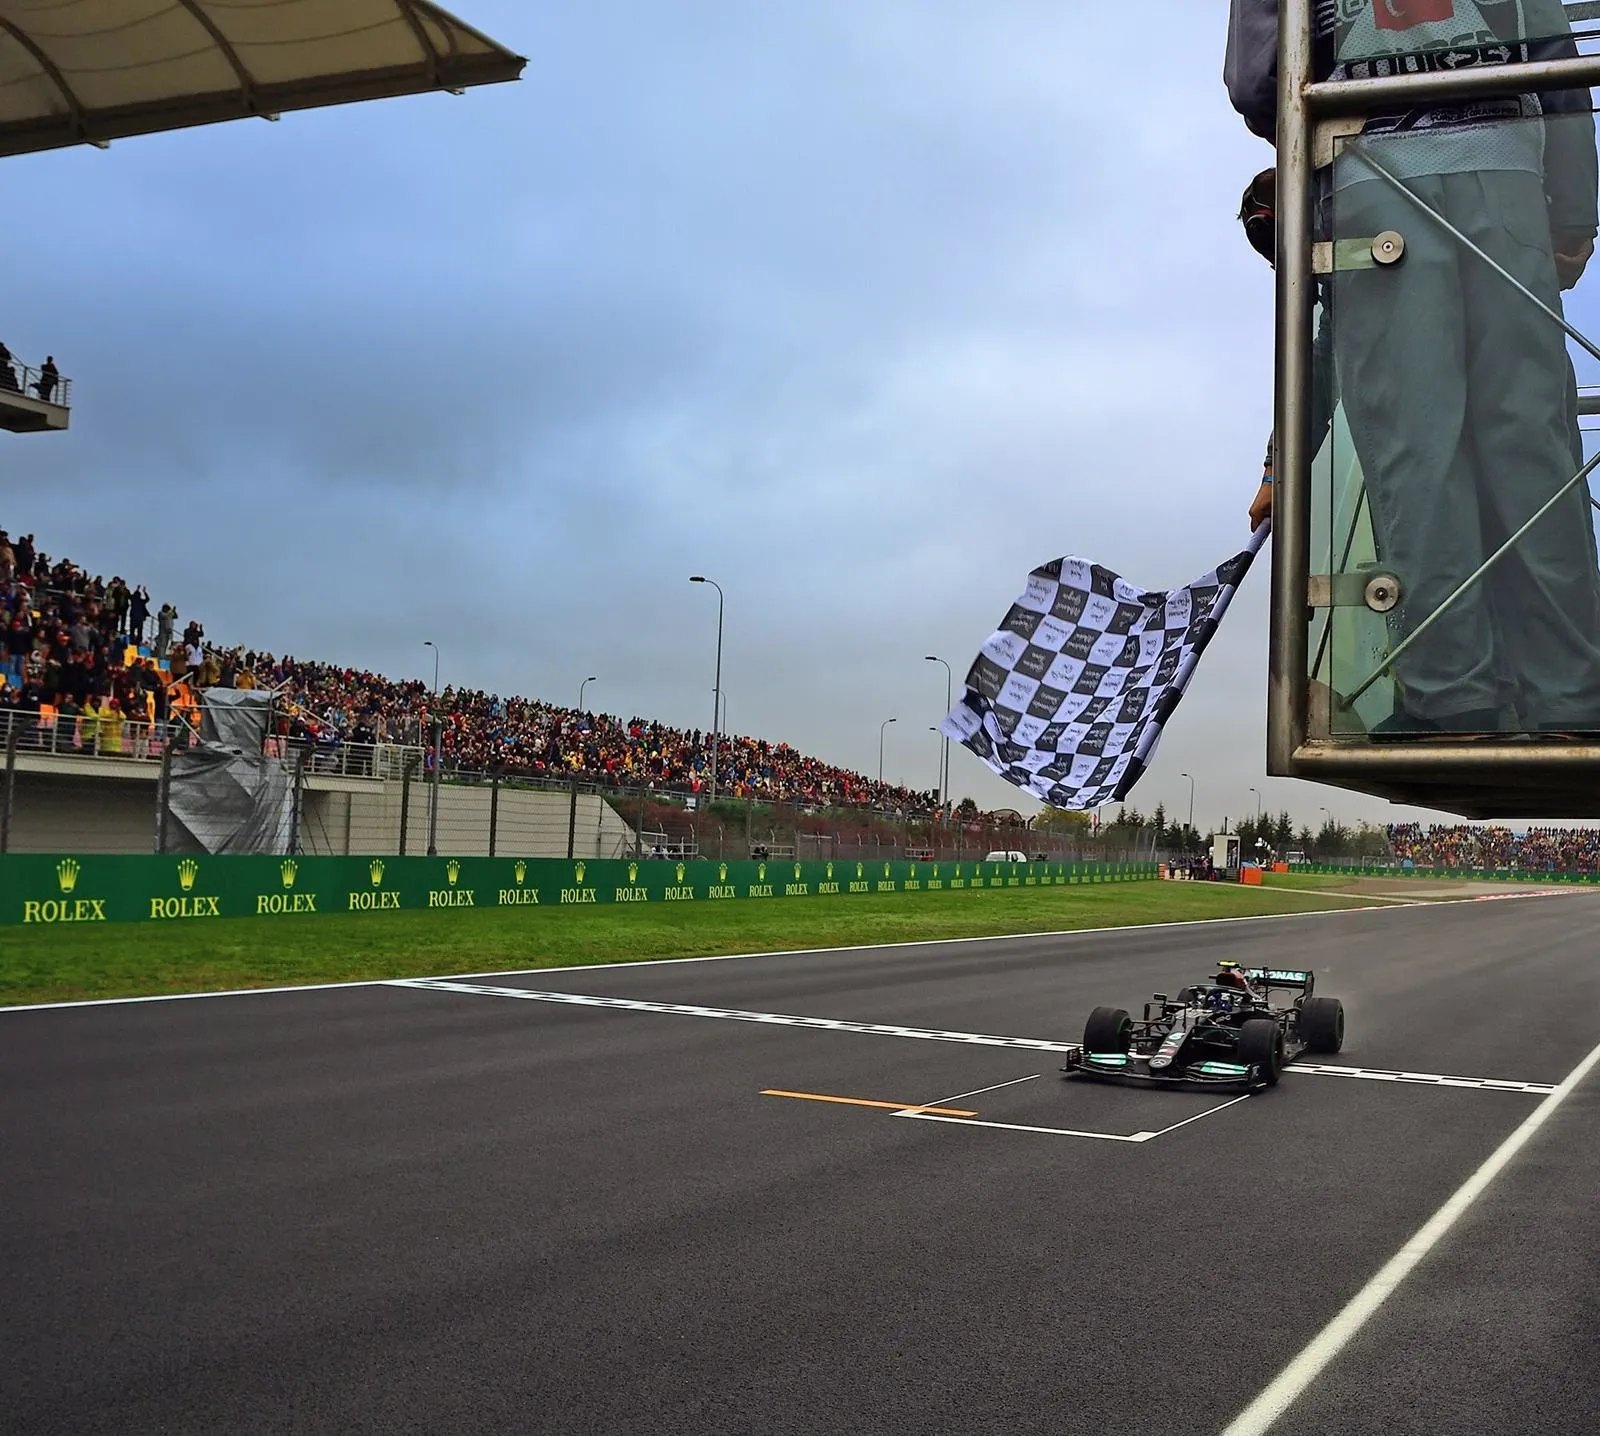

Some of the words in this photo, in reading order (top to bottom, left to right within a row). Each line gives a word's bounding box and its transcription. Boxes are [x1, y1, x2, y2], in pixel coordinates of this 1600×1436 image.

[750, 885, 773, 897] ROLEX
[786, 884, 808, 895] ROLEX
[819, 882, 839, 894] ROLEX
[850, 881, 869, 892] ROLEX
[878, 881, 895, 891] ROLEX
[905, 880, 919, 889] ROLEX
[499, 889, 539, 904] ROLEX
[561, 889, 596, 903] ROLEX
[616, 888, 648, 902] ROLEX
[665, 887, 694, 900] ROLEX
[709, 886, 736, 898] ROLEX
[257, 895, 316, 914] ROLEX
[349, 892, 400, 910] ROLEX
[429, 891, 474, 907] ROLEX
[24, 900, 106, 922] ROLEX
[150, 897, 219, 917] ROLEX
